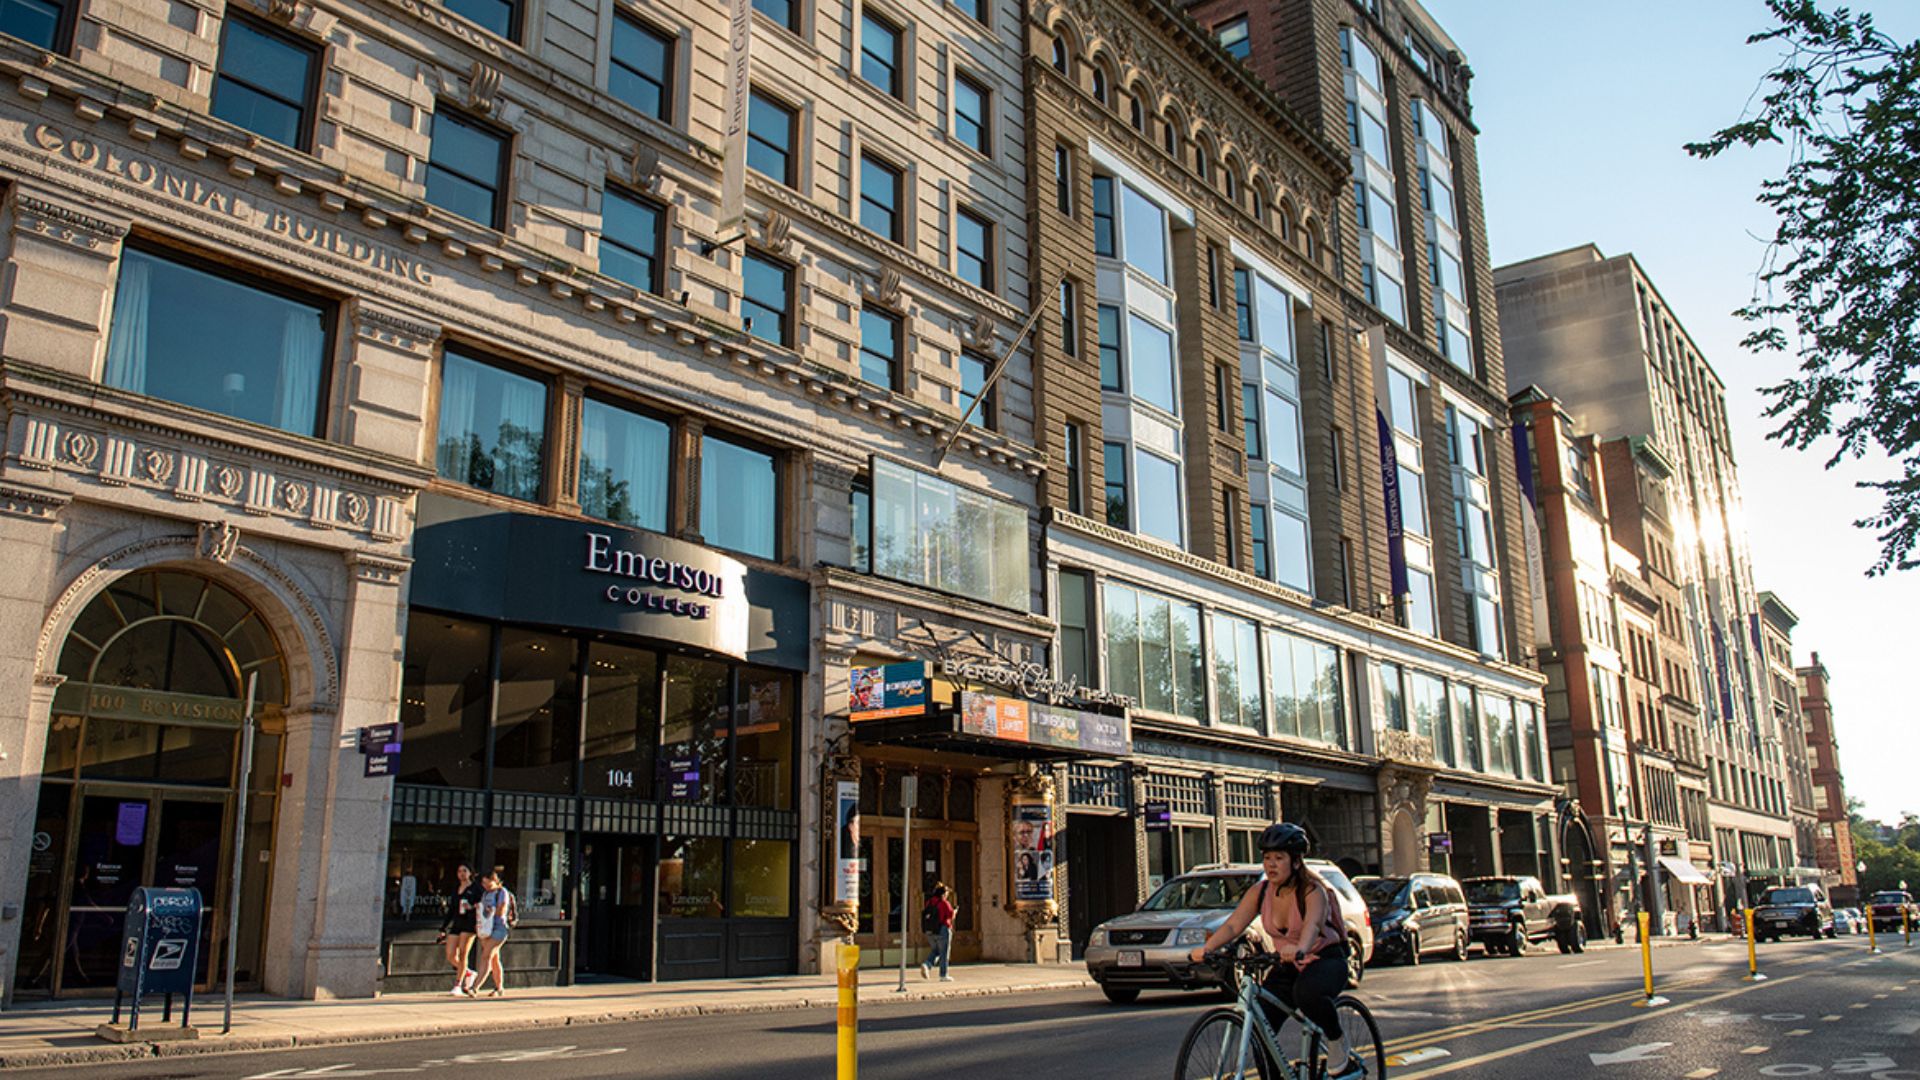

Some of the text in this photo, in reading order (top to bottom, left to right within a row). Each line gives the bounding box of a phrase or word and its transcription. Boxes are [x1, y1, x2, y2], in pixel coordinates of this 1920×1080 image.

[728, 0, 746, 137] Emerson Colle
[34, 122, 435, 288] COLONIAL BUILDING
[1388, 488, 1402, 537] Emerson
[584, 532, 724, 599] Emerson
[606, 585, 711, 619] COLLEGE
[91, 694, 241, 721] 100 BOYLSTON
[944, 659, 1021, 686] EMERSON
[1079, 685, 1138, 709] THEATRE
[607, 769, 633, 788] 104
